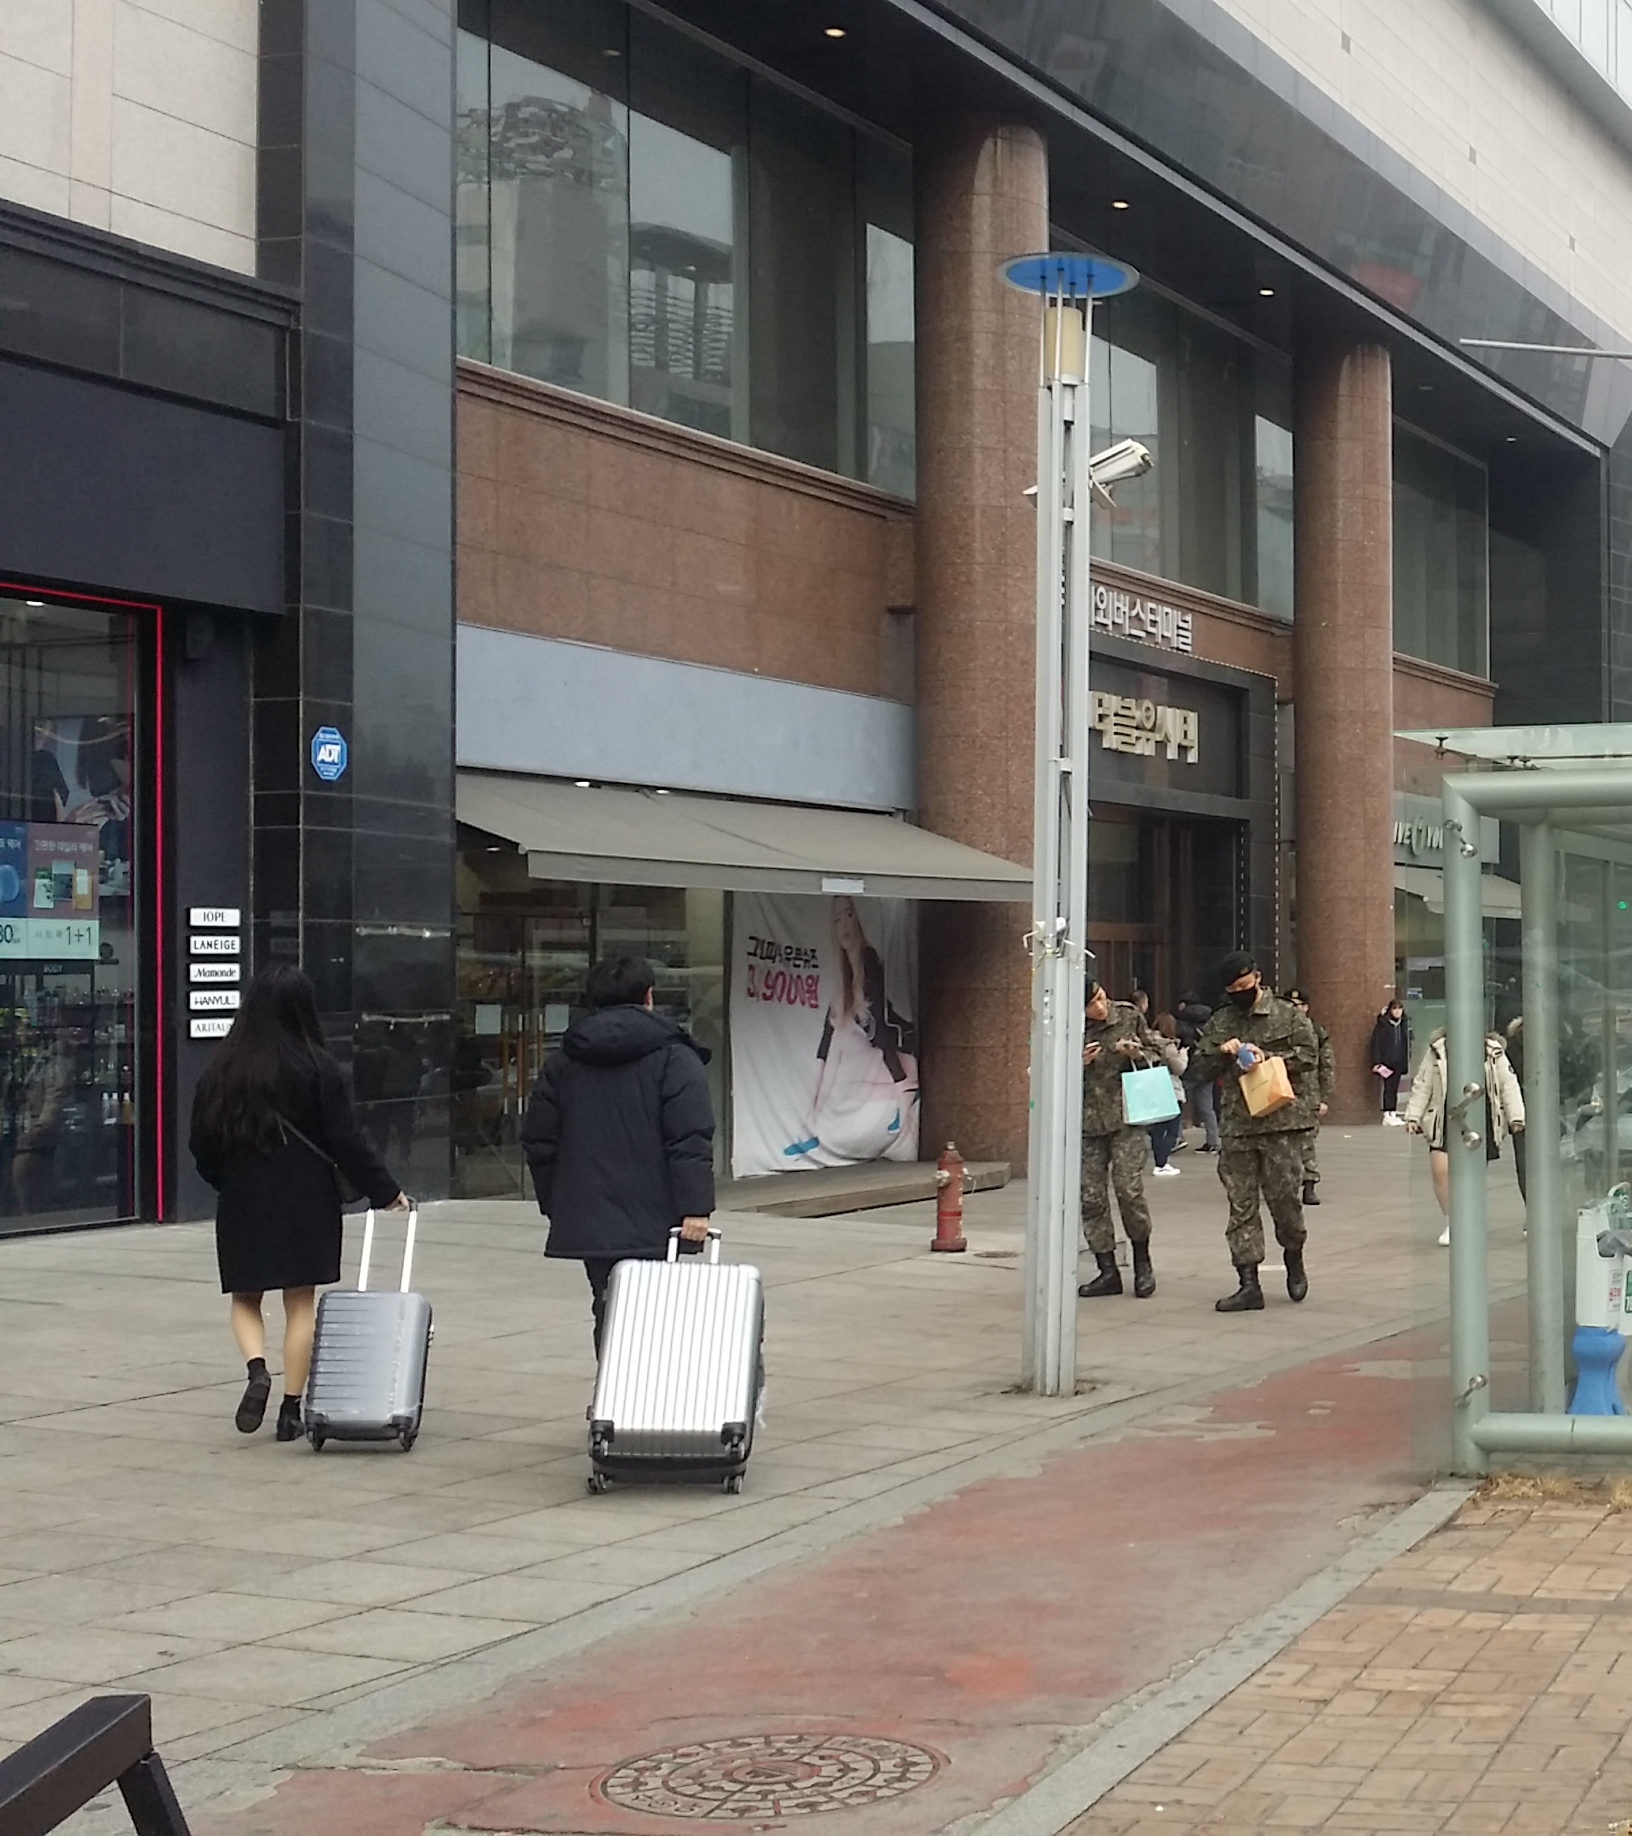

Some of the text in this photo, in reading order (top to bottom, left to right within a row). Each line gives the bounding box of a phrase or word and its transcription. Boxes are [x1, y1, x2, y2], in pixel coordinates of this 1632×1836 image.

[1091, 586, 1192, 652] 외버스터미널
[317, 744, 340, 764] ADT
[203, 911, 226, 922] IOPE
[194, 940, 236, 951] LANEIGE
[194, 967, 236, 978] Mamonde
[194, 995, 236, 1006] HANYUL
